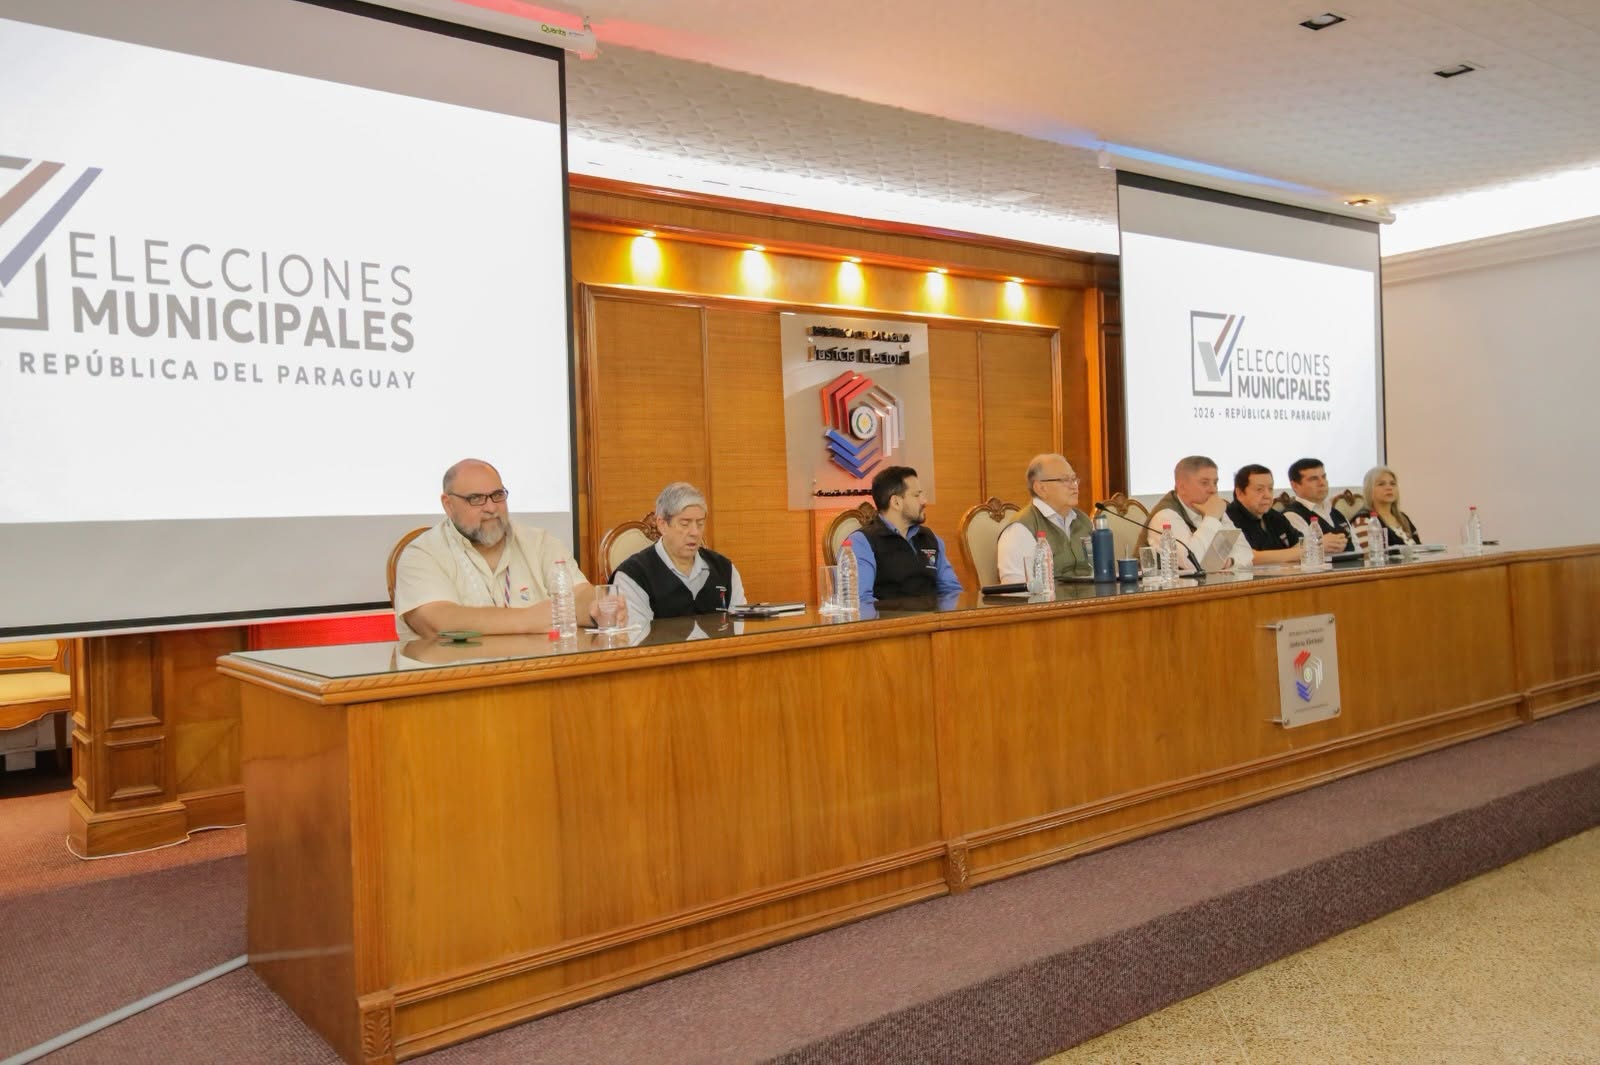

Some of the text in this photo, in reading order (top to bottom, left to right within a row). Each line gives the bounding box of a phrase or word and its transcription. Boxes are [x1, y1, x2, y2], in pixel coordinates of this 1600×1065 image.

[69, 231, 413, 307] ELECCIONES
[71, 286, 415, 353] MUNICIPALES
[19, 348, 416, 390] REPÚBLICA DEL PARAGUAY
[1237, 348, 1331, 377] ELECCIONES
[1238, 375, 1331, 402] MUNICIPALES
[1193, 407, 1215, 419] 2026
[1225, 406, 1271, 420] REPÚBLICA
[1273, 408, 1289, 421] DEL
[1290, 409, 1332, 422] PARAGUAY
